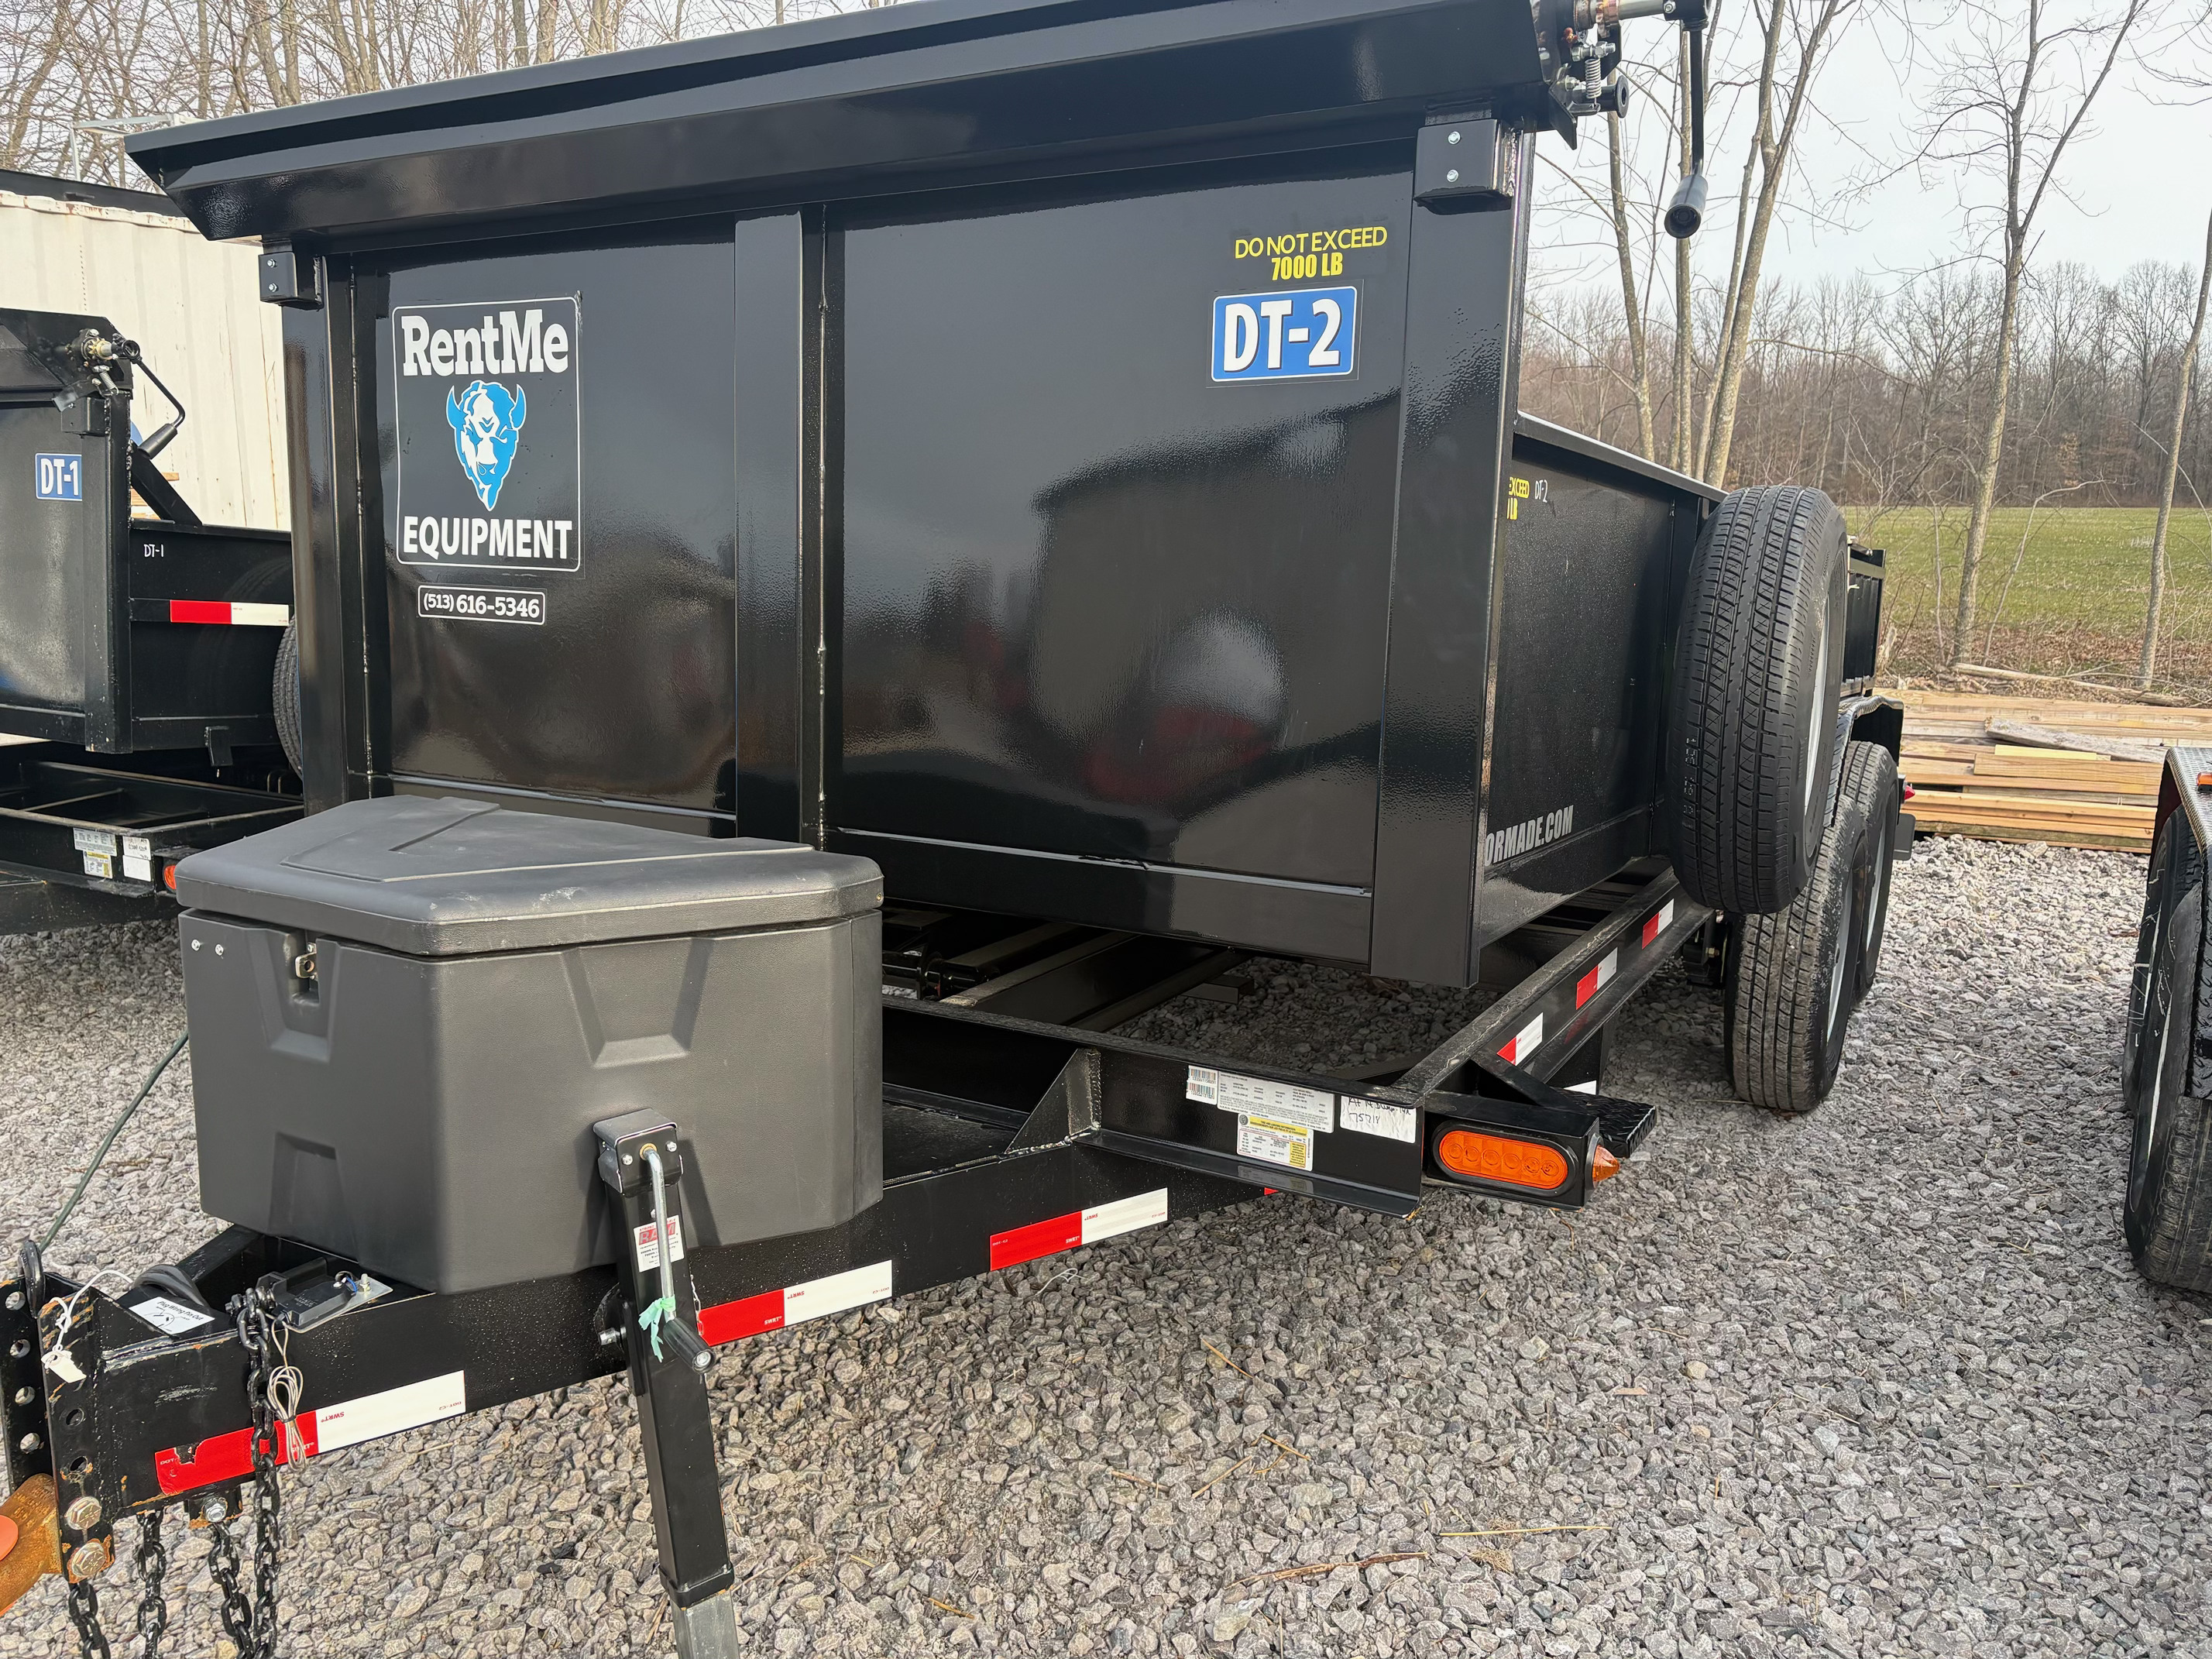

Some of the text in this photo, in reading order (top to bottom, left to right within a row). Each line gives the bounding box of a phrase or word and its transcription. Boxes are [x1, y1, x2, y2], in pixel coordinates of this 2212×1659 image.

[1235, 226, 1388, 259] DO NOT EXCEED
[1271, 252, 1343, 281] 7000 LB
[401, 309, 568, 376] RentMe
[1223, 297, 1342, 373] DT-2
[40, 458, 79, 496] DT-1
[143, 544, 164, 558] DT-1
[404, 516, 572, 560] EQUIPMENT
[424, 592, 540, 618] (513) 616-5346
